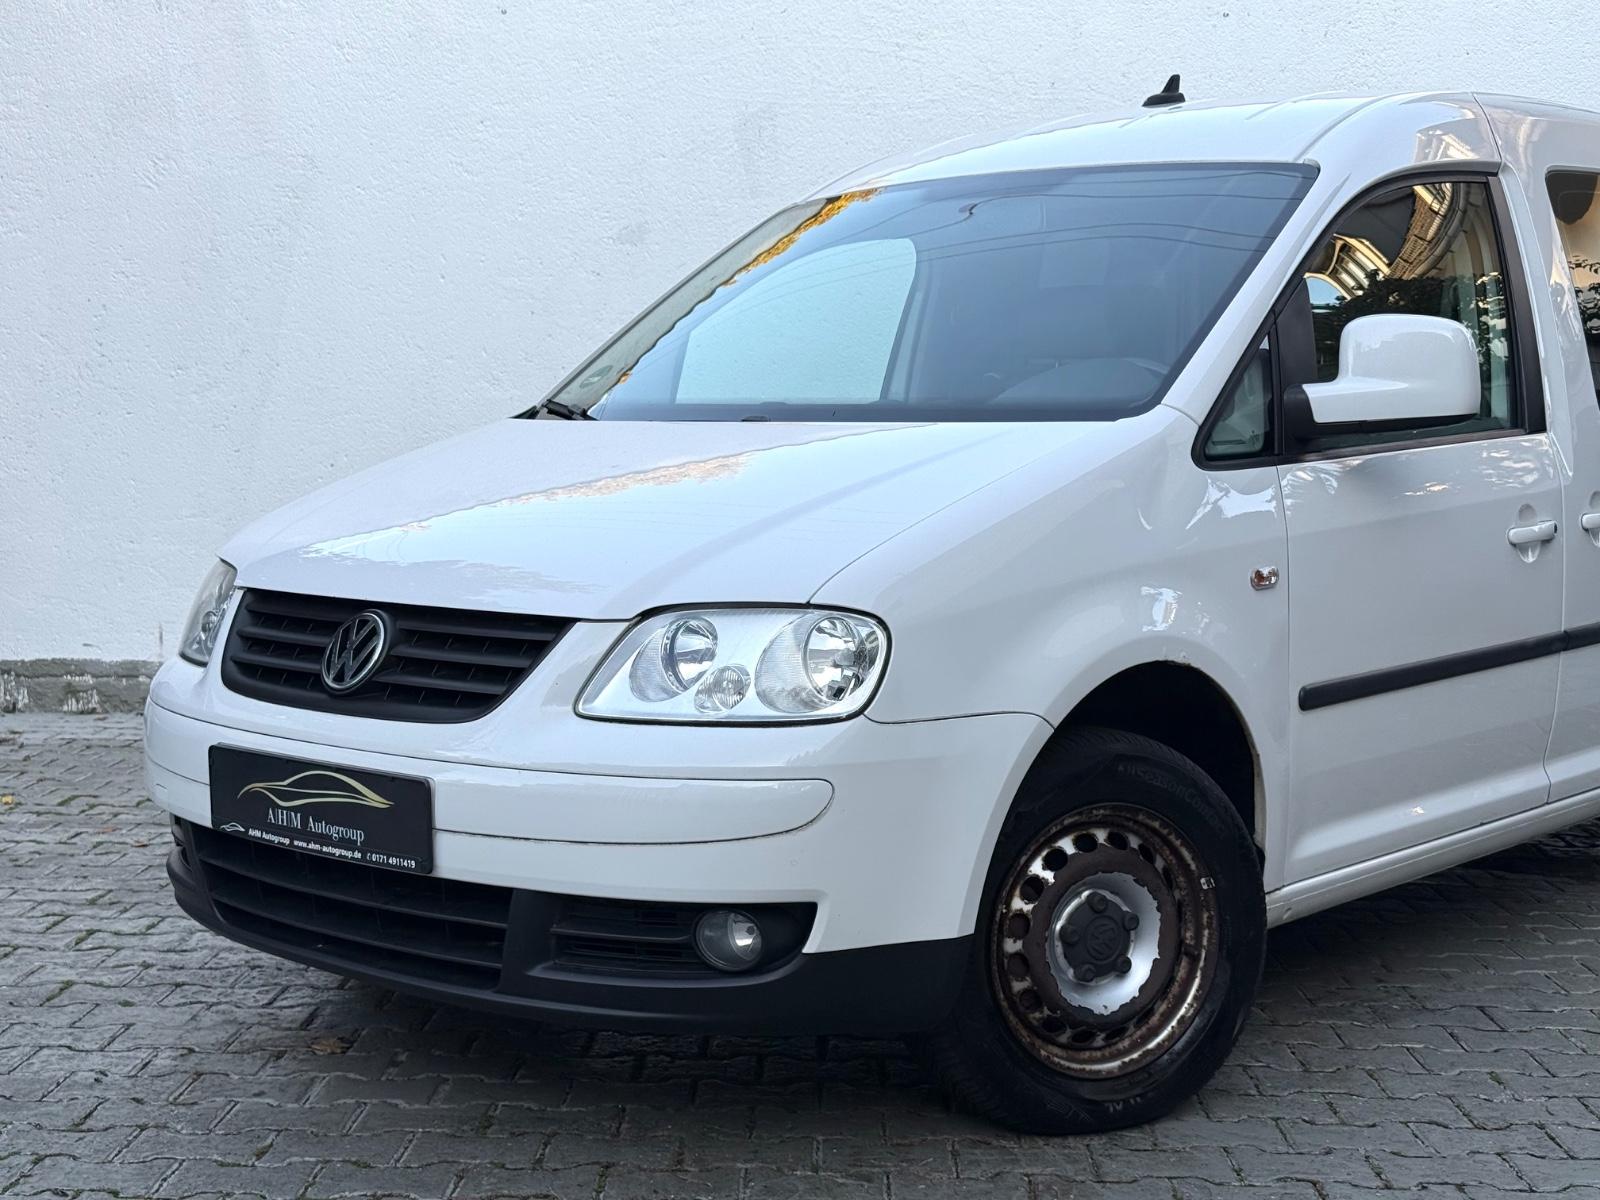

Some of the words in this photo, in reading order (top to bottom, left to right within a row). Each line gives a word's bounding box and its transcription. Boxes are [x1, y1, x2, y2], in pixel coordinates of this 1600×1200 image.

[248, 828, 262, 839] AHM
[262, 830, 290, 847] Autogroup
[293, 839, 362, 860] www.ahm-autogroup.de
[372, 854, 387, 864] 0171
[388, 856, 416, 869] 4911419
[307, 816, 365, 846] Autogroup
